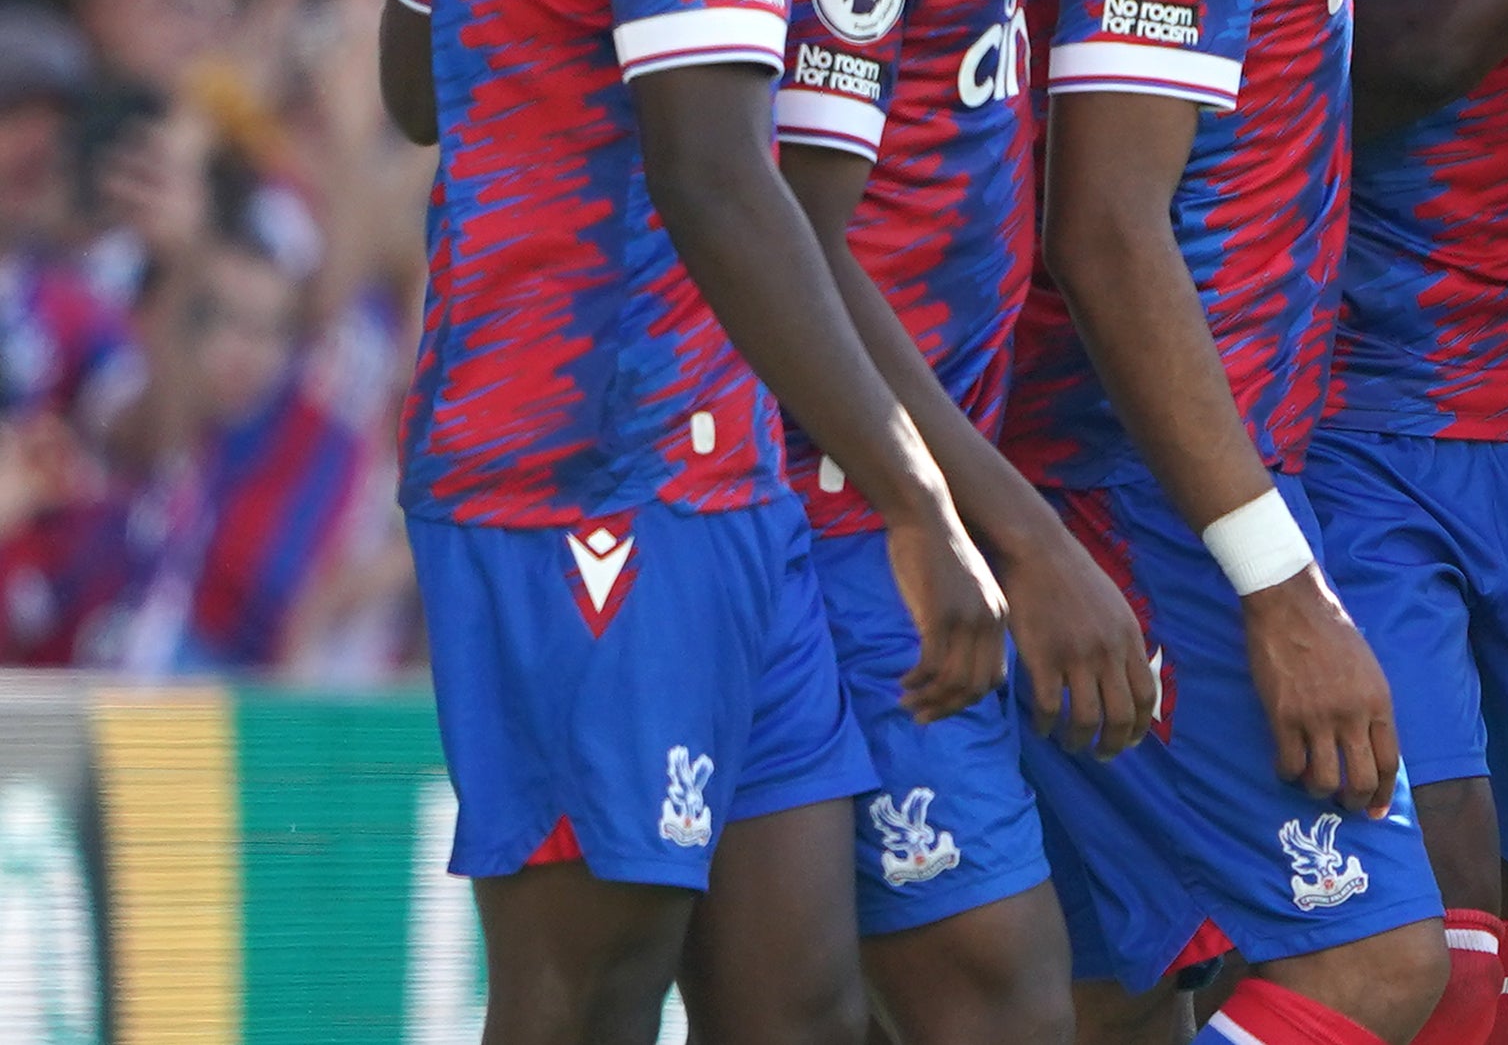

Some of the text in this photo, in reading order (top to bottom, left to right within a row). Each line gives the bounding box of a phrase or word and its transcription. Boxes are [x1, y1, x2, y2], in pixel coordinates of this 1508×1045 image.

[1140, 2, 1193, 26] room
[798, 43, 880, 81] No room
